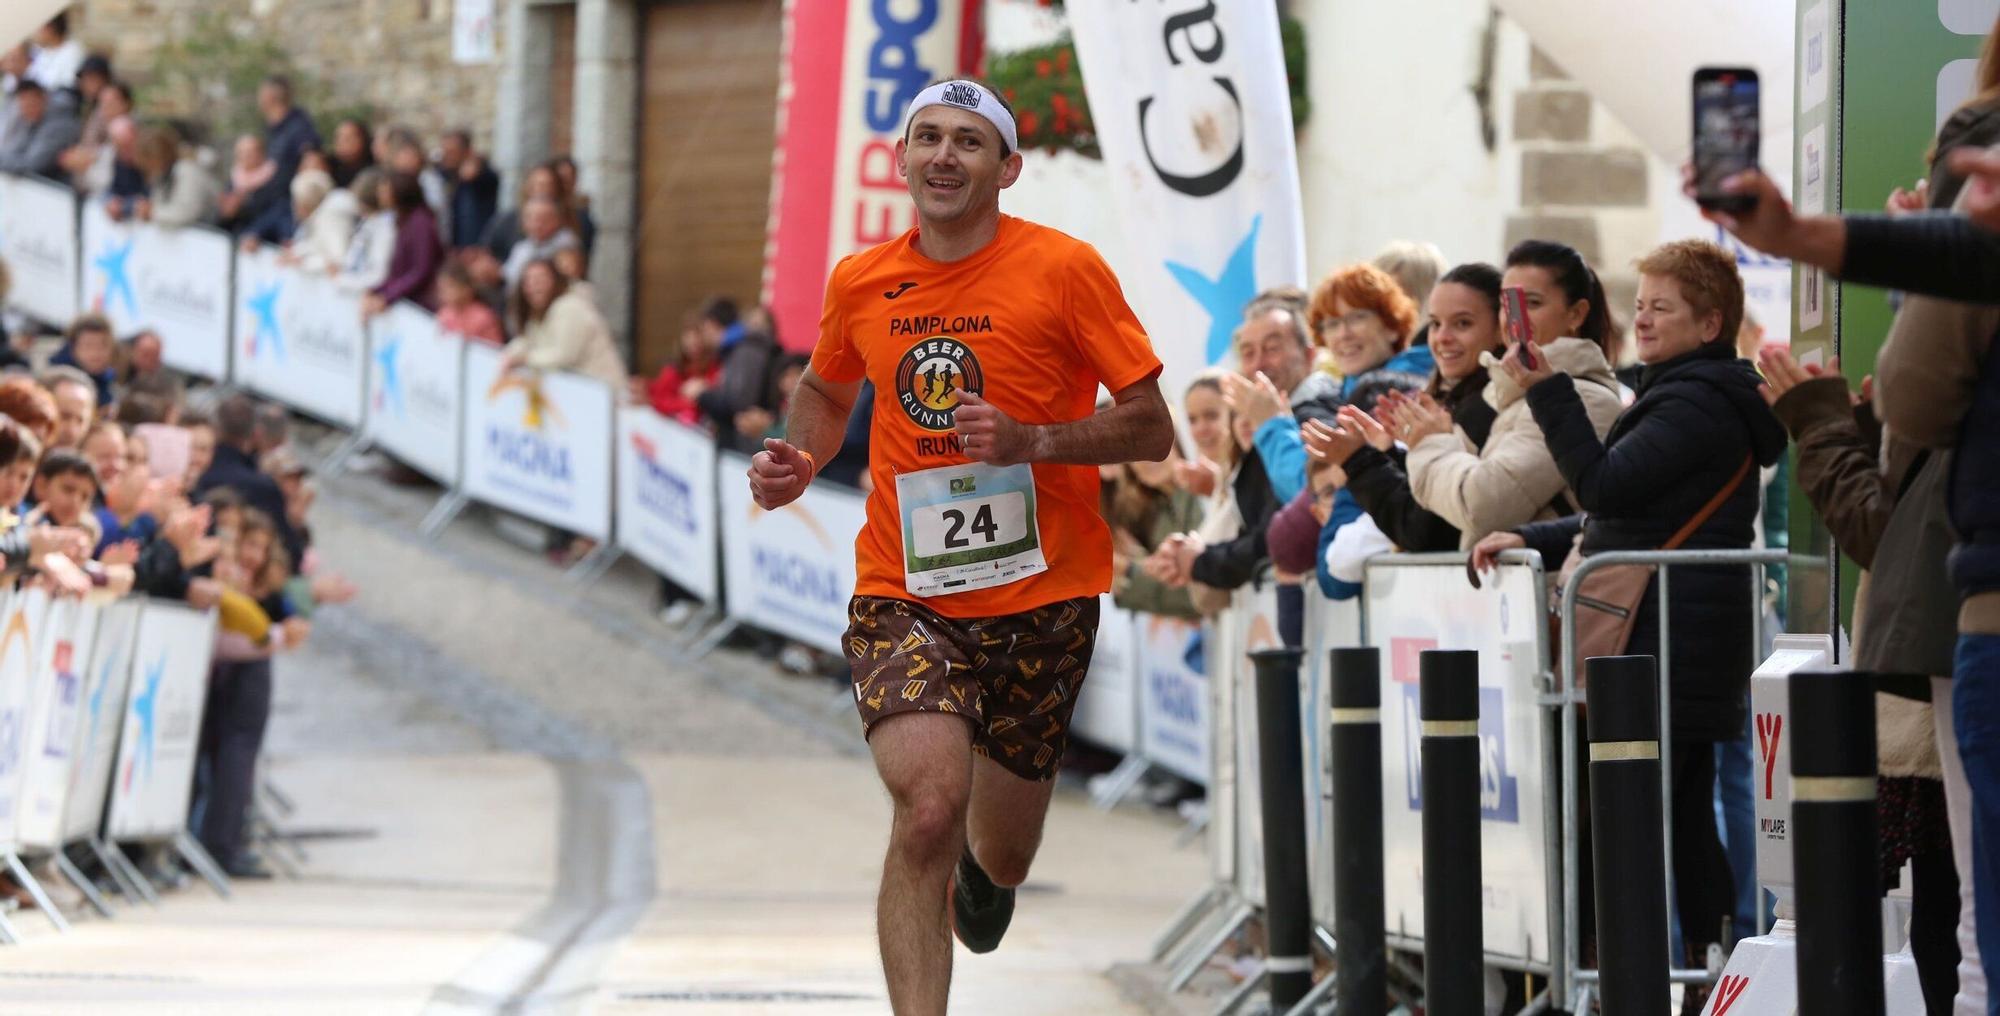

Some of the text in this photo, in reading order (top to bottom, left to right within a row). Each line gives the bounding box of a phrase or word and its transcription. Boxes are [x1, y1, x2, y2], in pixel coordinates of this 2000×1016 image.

[944, 91, 977, 106] RUNNERS
[1138, 0, 1244, 197] Ca
[890, 315, 992, 336] PAMPLONA
[913, 341, 965, 361] BEER
[916, 432, 966, 457] IRUÑ
[942, 504, 998, 549] 24
[1761, 818, 1785, 833] MYLAPS
